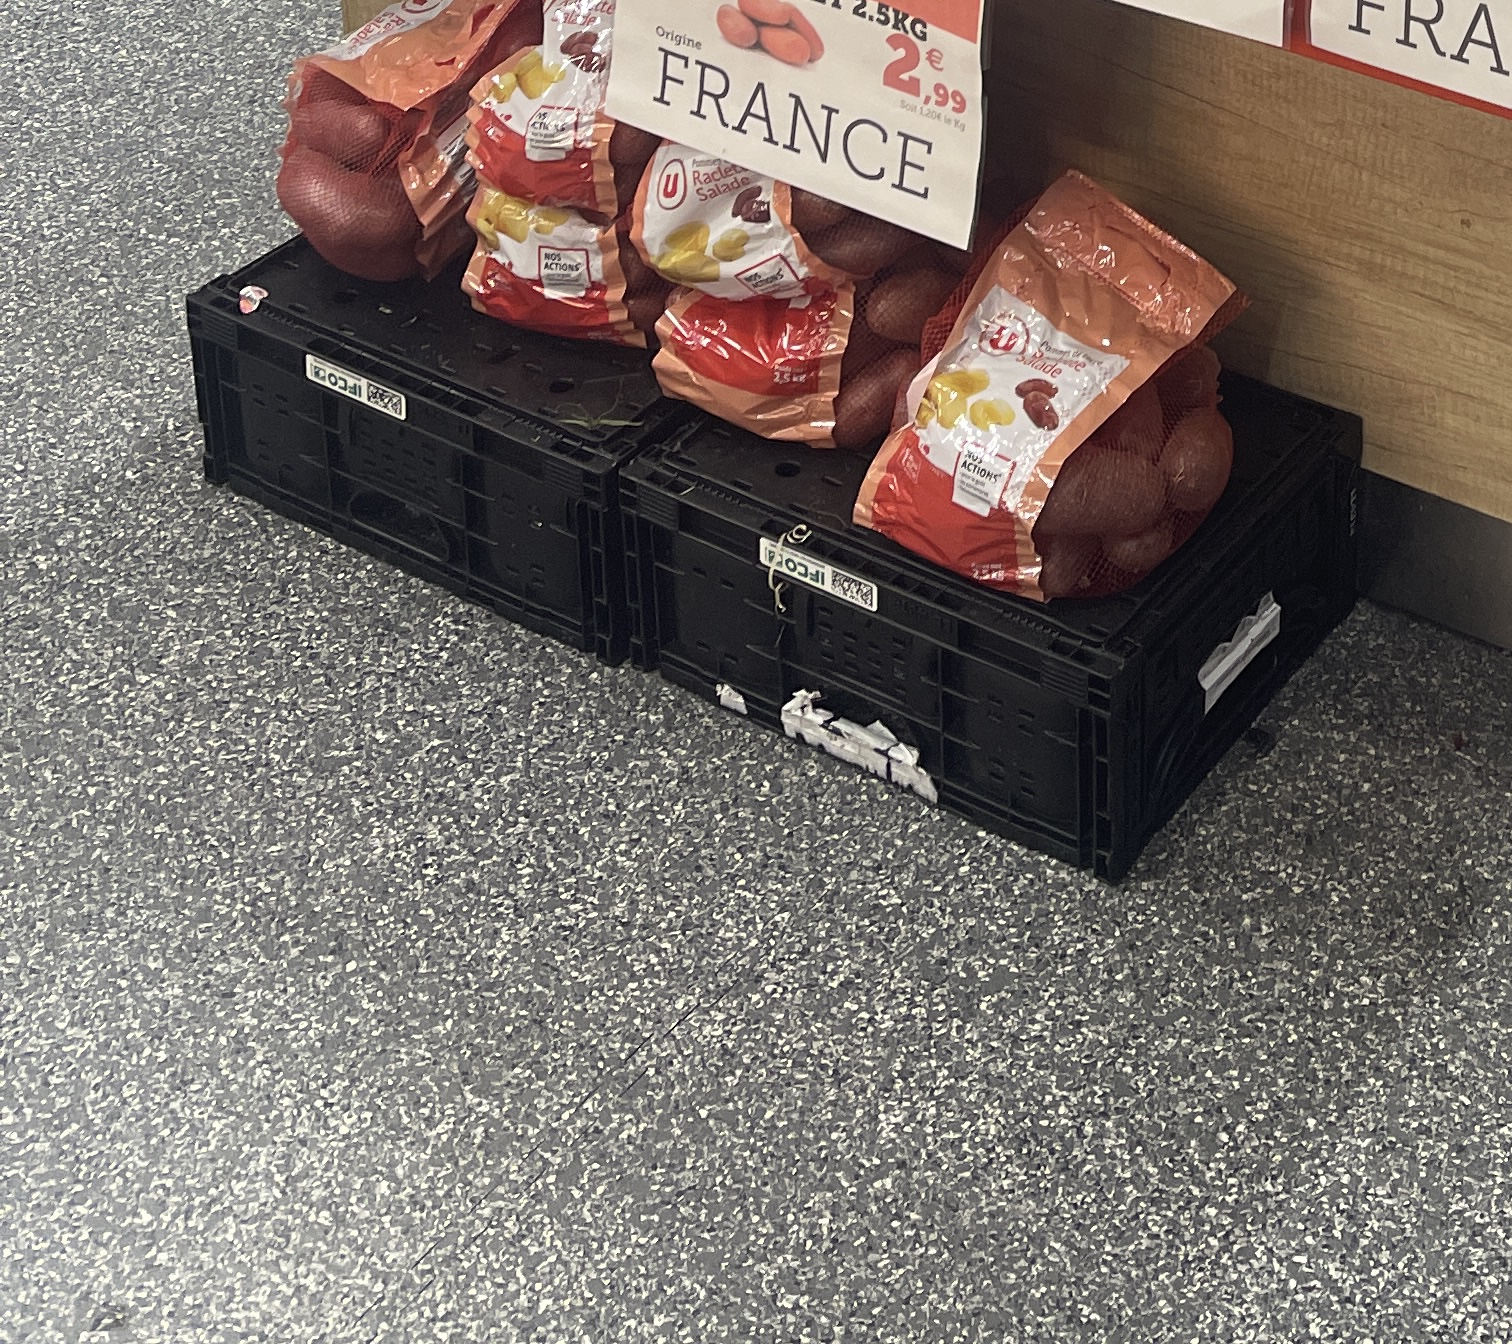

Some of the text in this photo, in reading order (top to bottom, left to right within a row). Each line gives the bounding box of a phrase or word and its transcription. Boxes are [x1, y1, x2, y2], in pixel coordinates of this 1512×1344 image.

[655, 25, 702, 51] Origine
[652, 47, 933, 199] FRANCE
[696, 175, 751, 202] Salade
[544, 252, 561, 262] NOS
[544, 262, 580, 272] ACTIONS
[328, 372, 362, 399] IFCO
[961, 462, 998, 484] ACTIONS
[785, 558, 825, 586] IFCO
